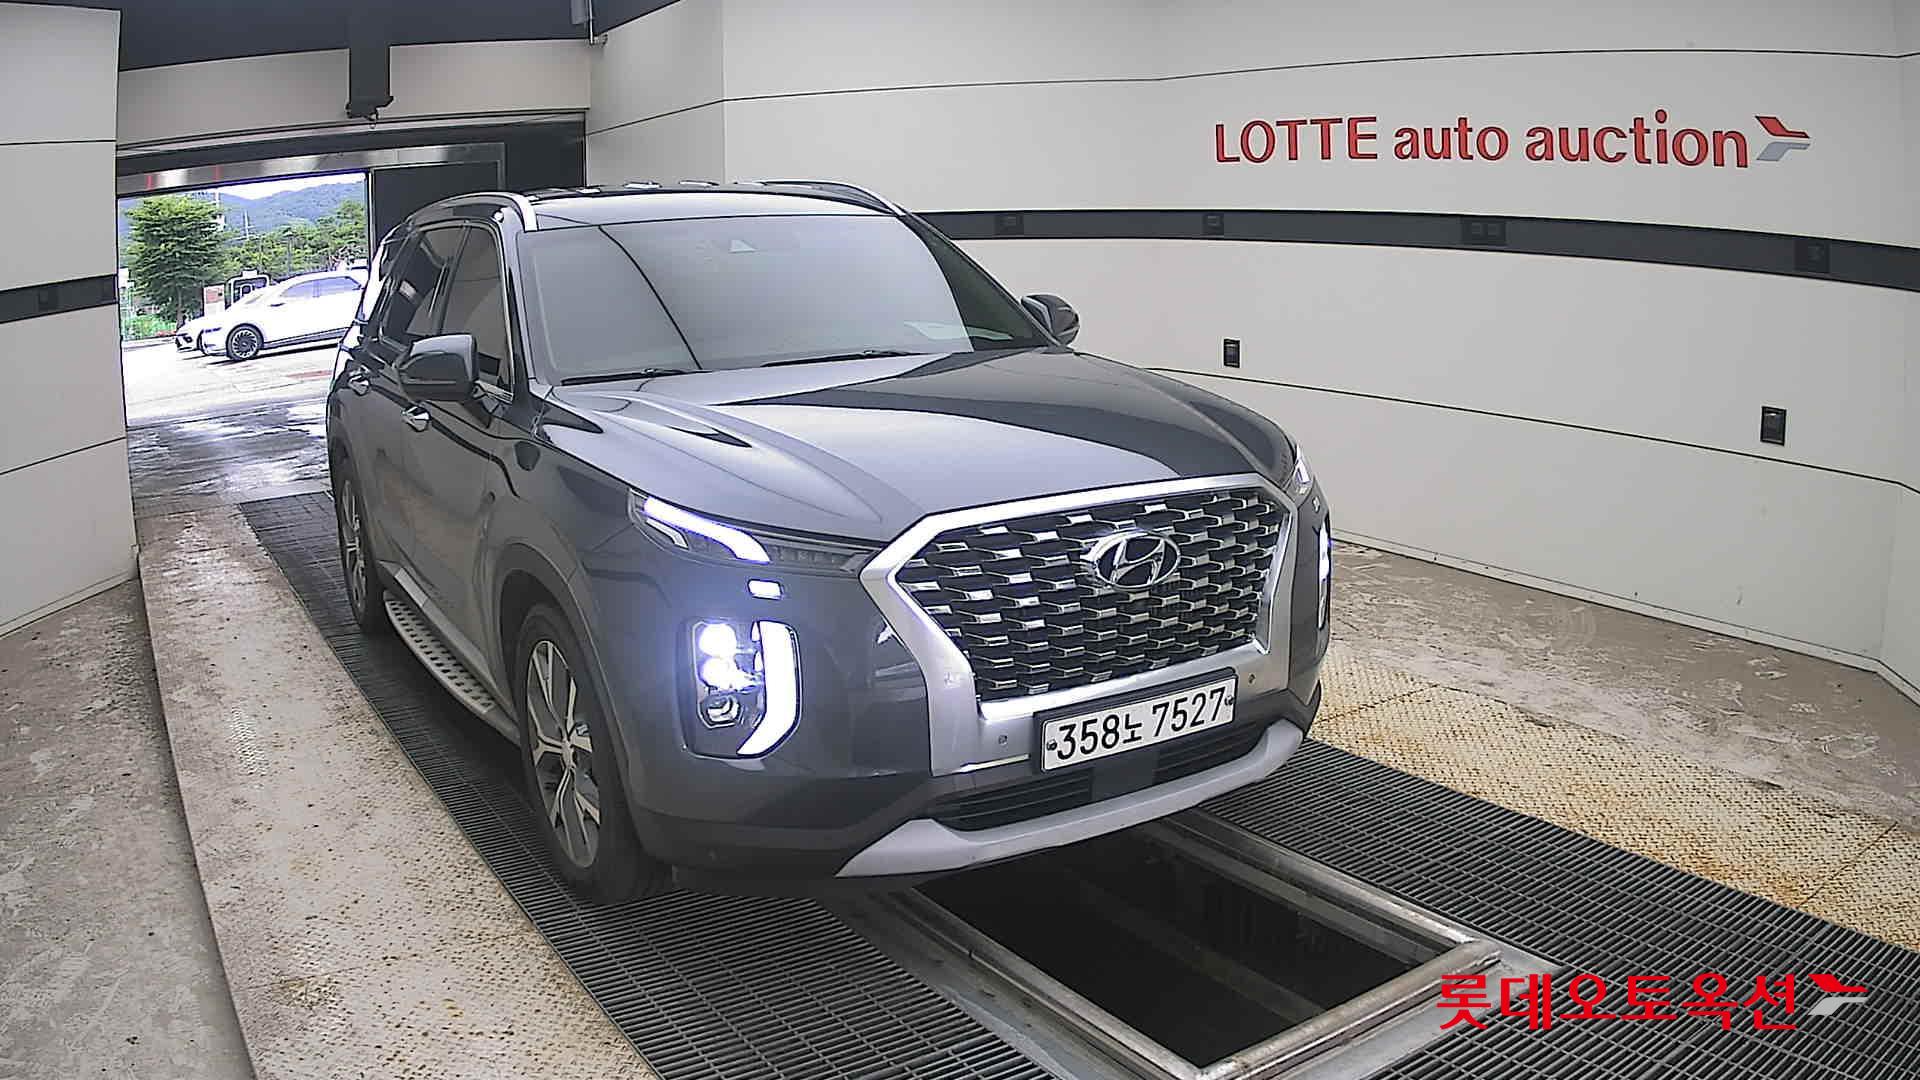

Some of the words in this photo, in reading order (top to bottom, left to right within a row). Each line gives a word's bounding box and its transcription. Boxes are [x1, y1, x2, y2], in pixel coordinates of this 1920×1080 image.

[1215, 116, 1379, 163] LOTTE
[1393, 117, 1510, 161] auto
[1525, 109, 1749, 168] auction
[1056, 712, 1143, 760] 358노
[1151, 686, 1226, 738] 7527
